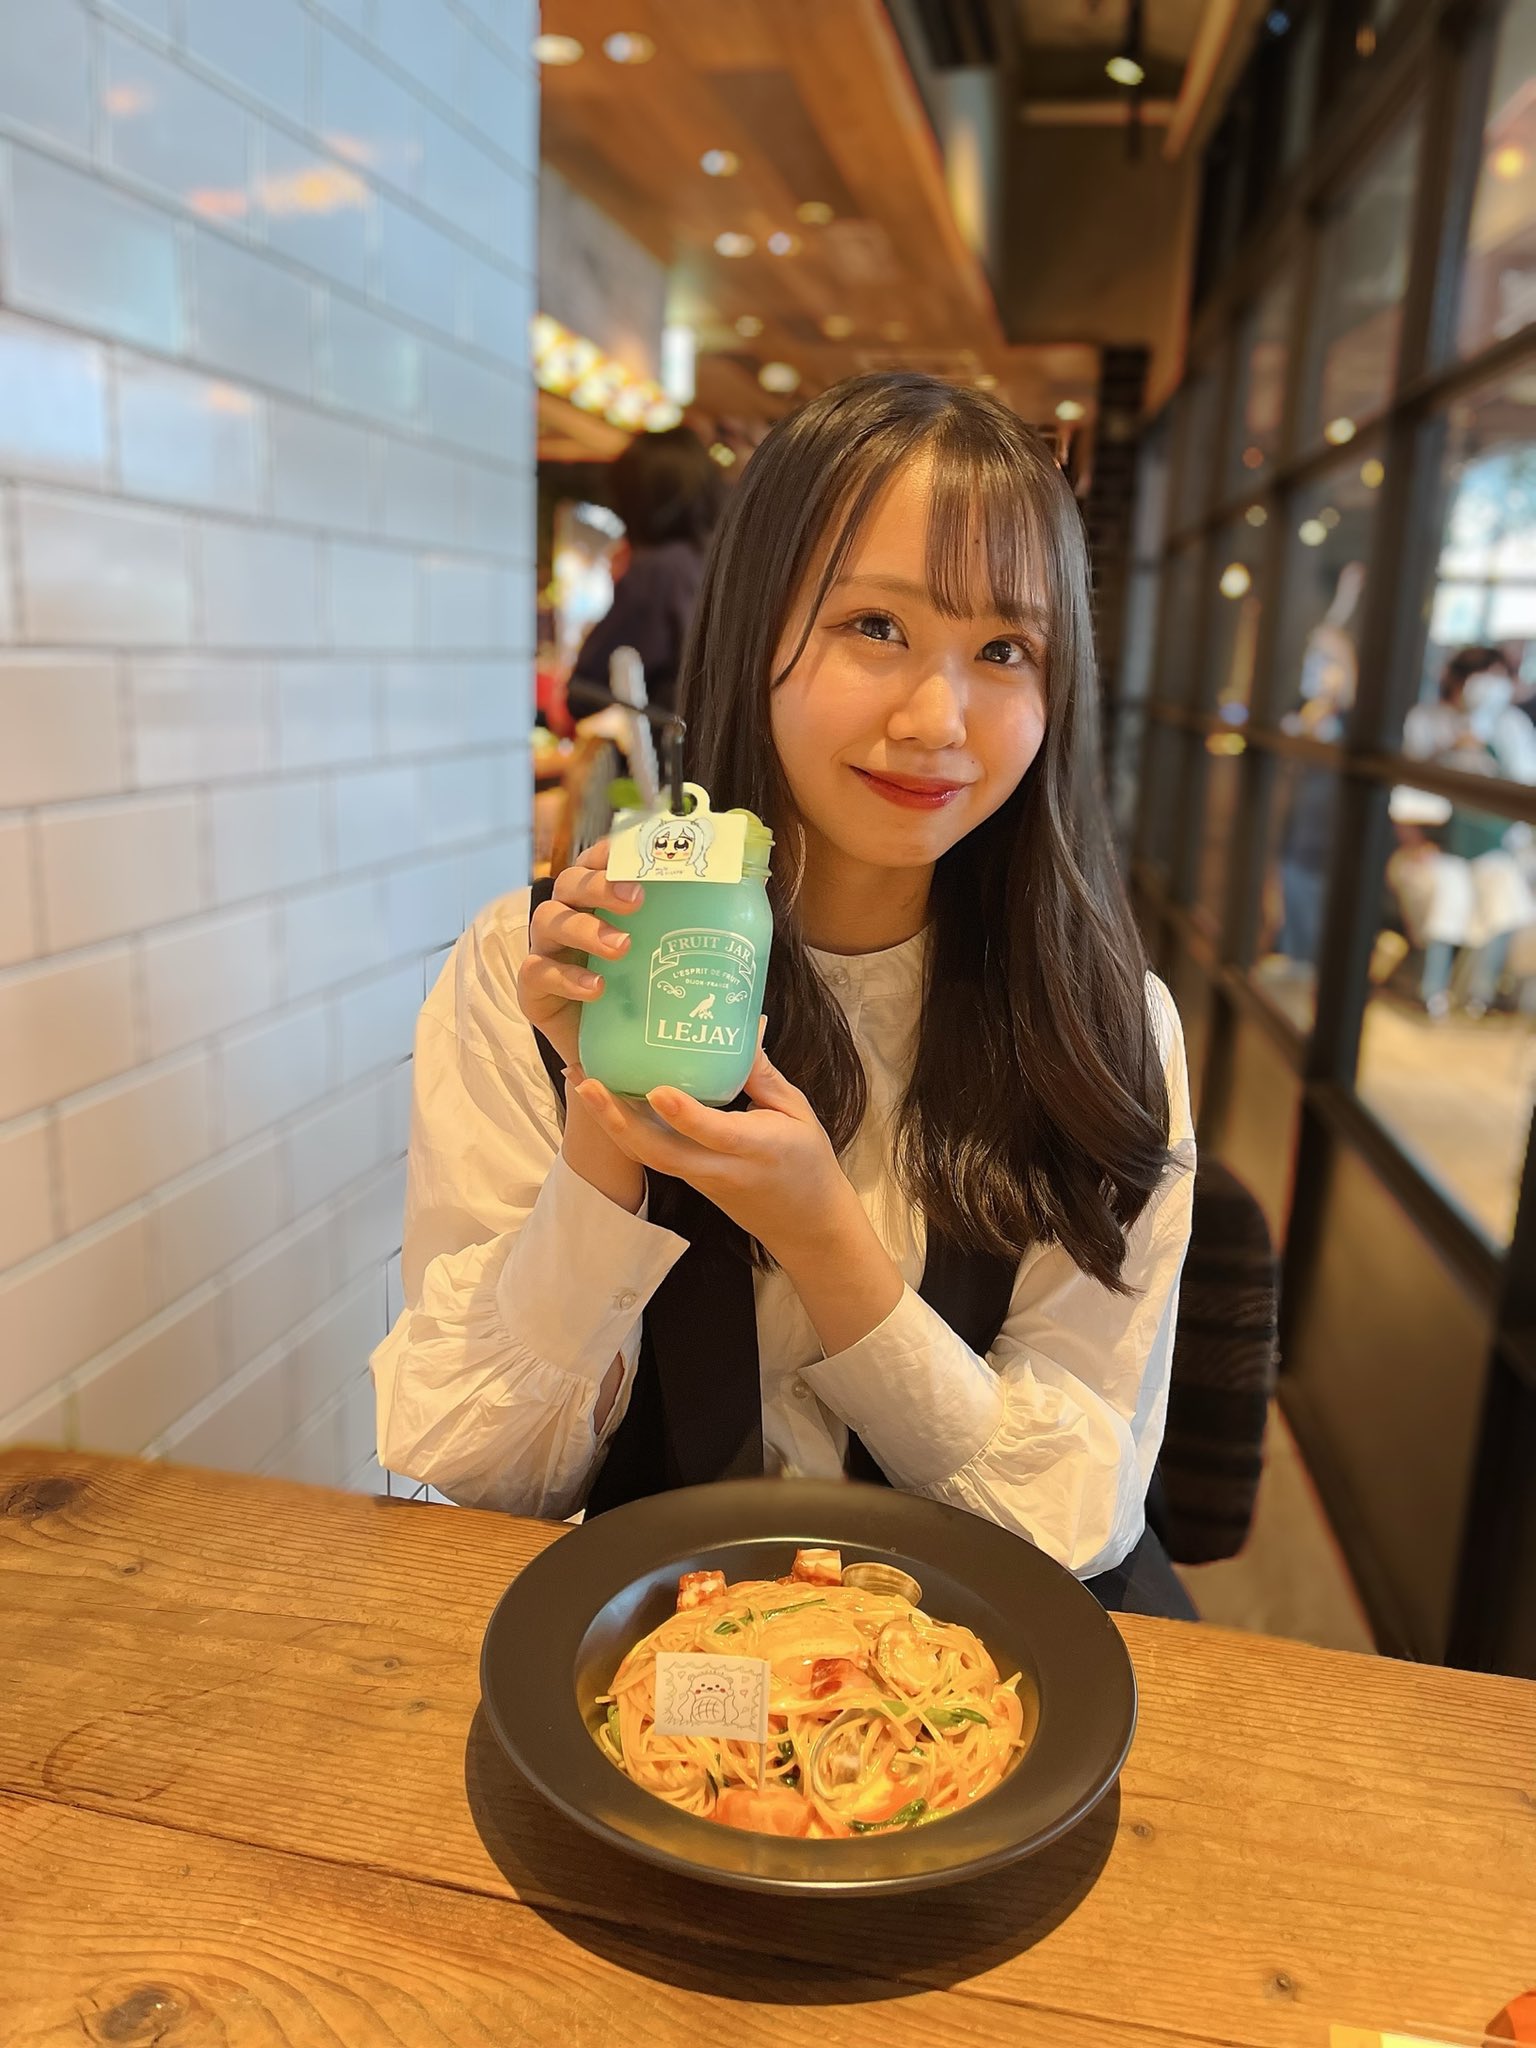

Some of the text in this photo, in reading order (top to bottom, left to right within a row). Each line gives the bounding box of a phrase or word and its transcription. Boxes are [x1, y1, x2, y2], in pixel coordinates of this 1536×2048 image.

[666, 936, 752, 963] FRUIT JAR
[672, 967, 741, 986] L'ESPRIT DE FRUIT
[657, 1019, 740, 1046] LEJAY
